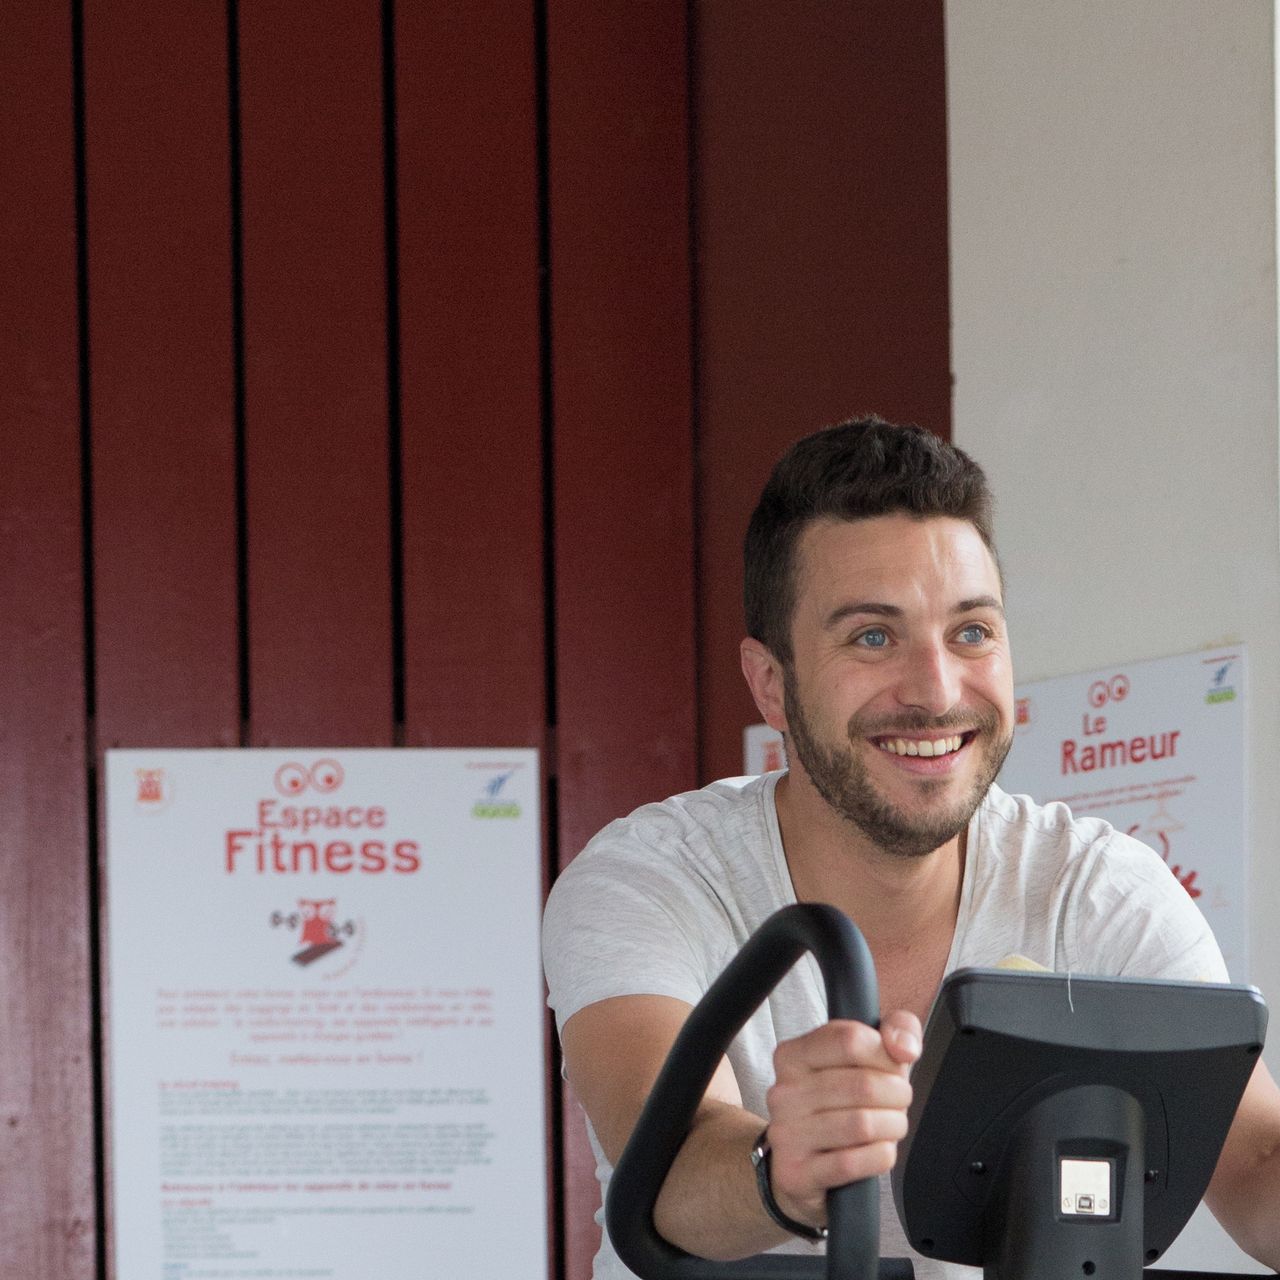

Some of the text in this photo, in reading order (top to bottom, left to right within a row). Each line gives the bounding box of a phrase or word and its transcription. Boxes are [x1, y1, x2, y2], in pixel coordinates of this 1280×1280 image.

[1083, 713, 1107, 736] Le
[1061, 731, 1181, 776] Rameur
[257, 799, 387, 835] Espace
[225, 829, 422, 874] Fitness
